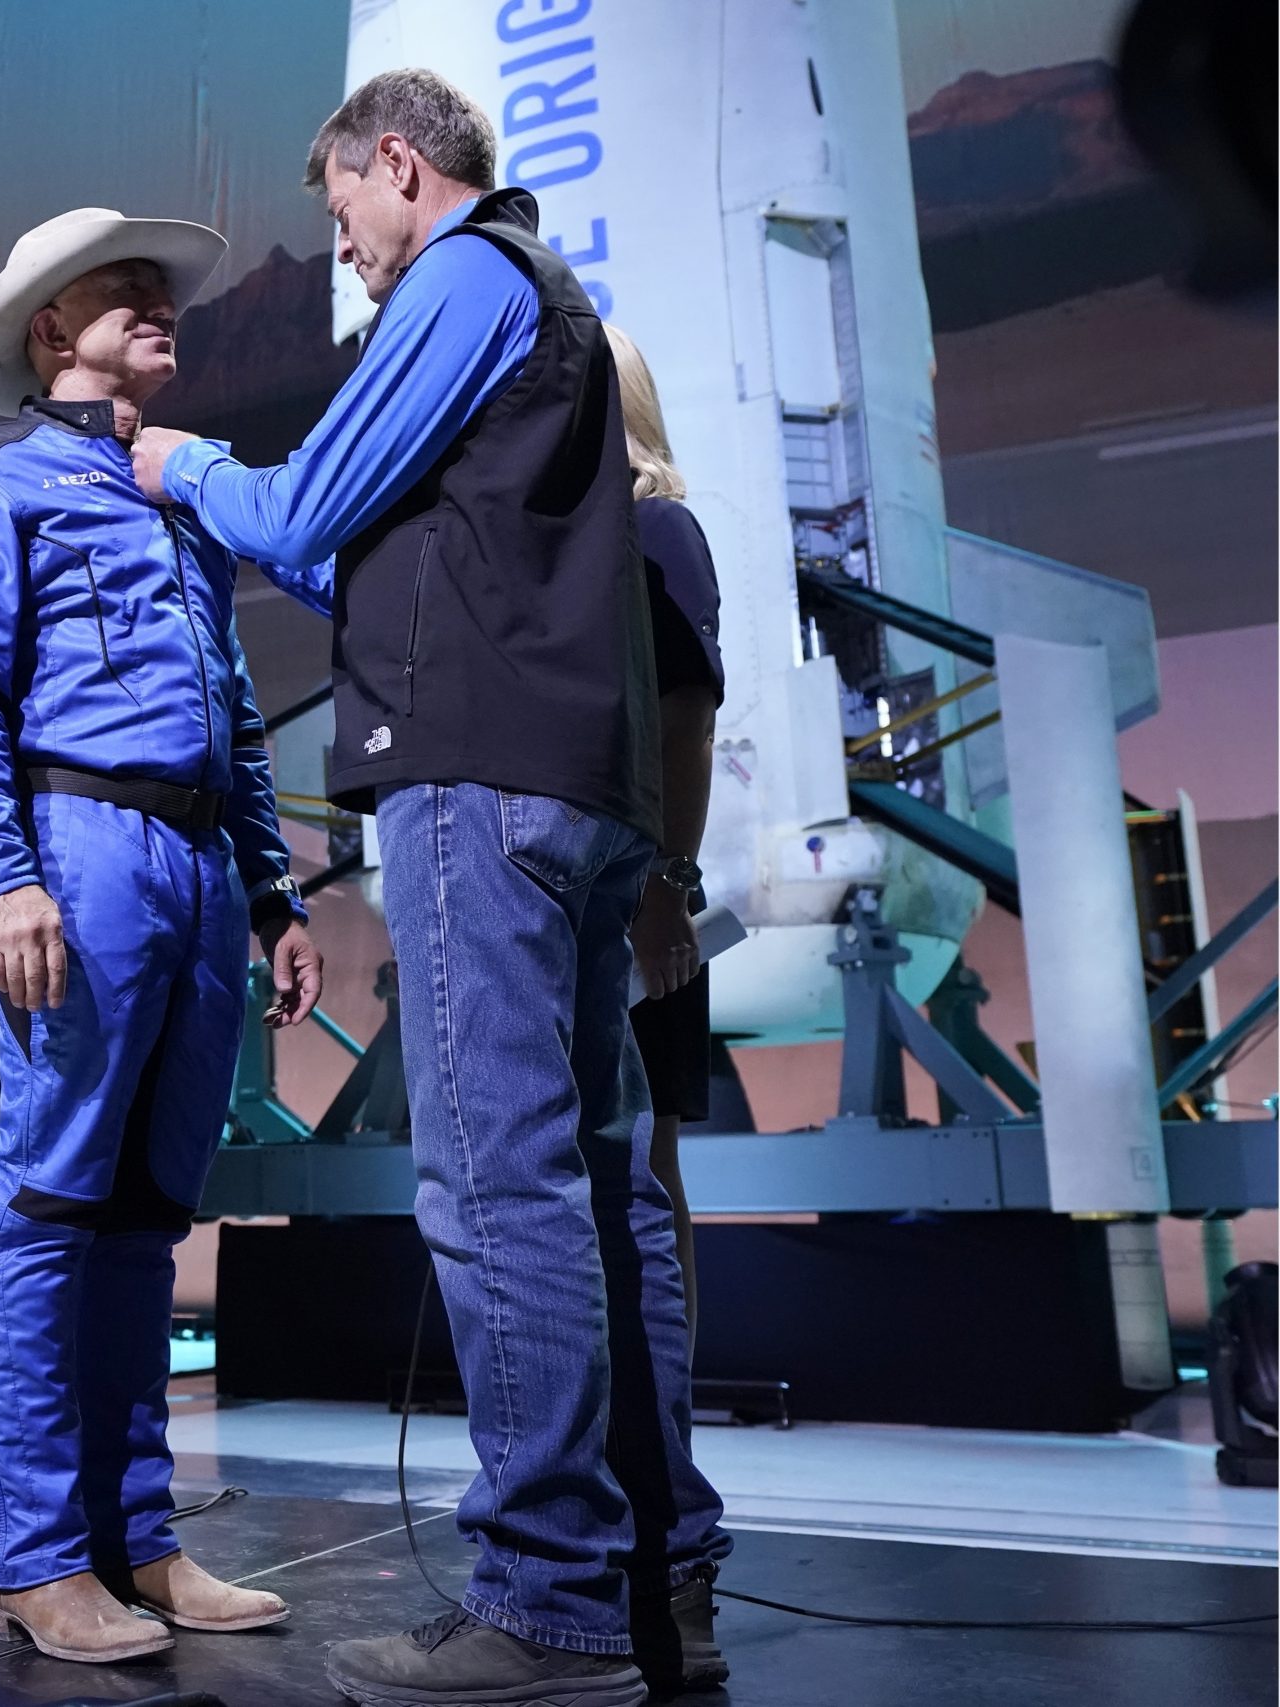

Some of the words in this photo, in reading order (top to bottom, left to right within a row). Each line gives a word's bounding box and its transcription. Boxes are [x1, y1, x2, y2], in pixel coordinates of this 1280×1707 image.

[43, 478, 55, 489] J.
[372, 727, 383, 738] THE
[364, 736, 382, 749] NORTH
[368, 744, 383, 754] FACE
